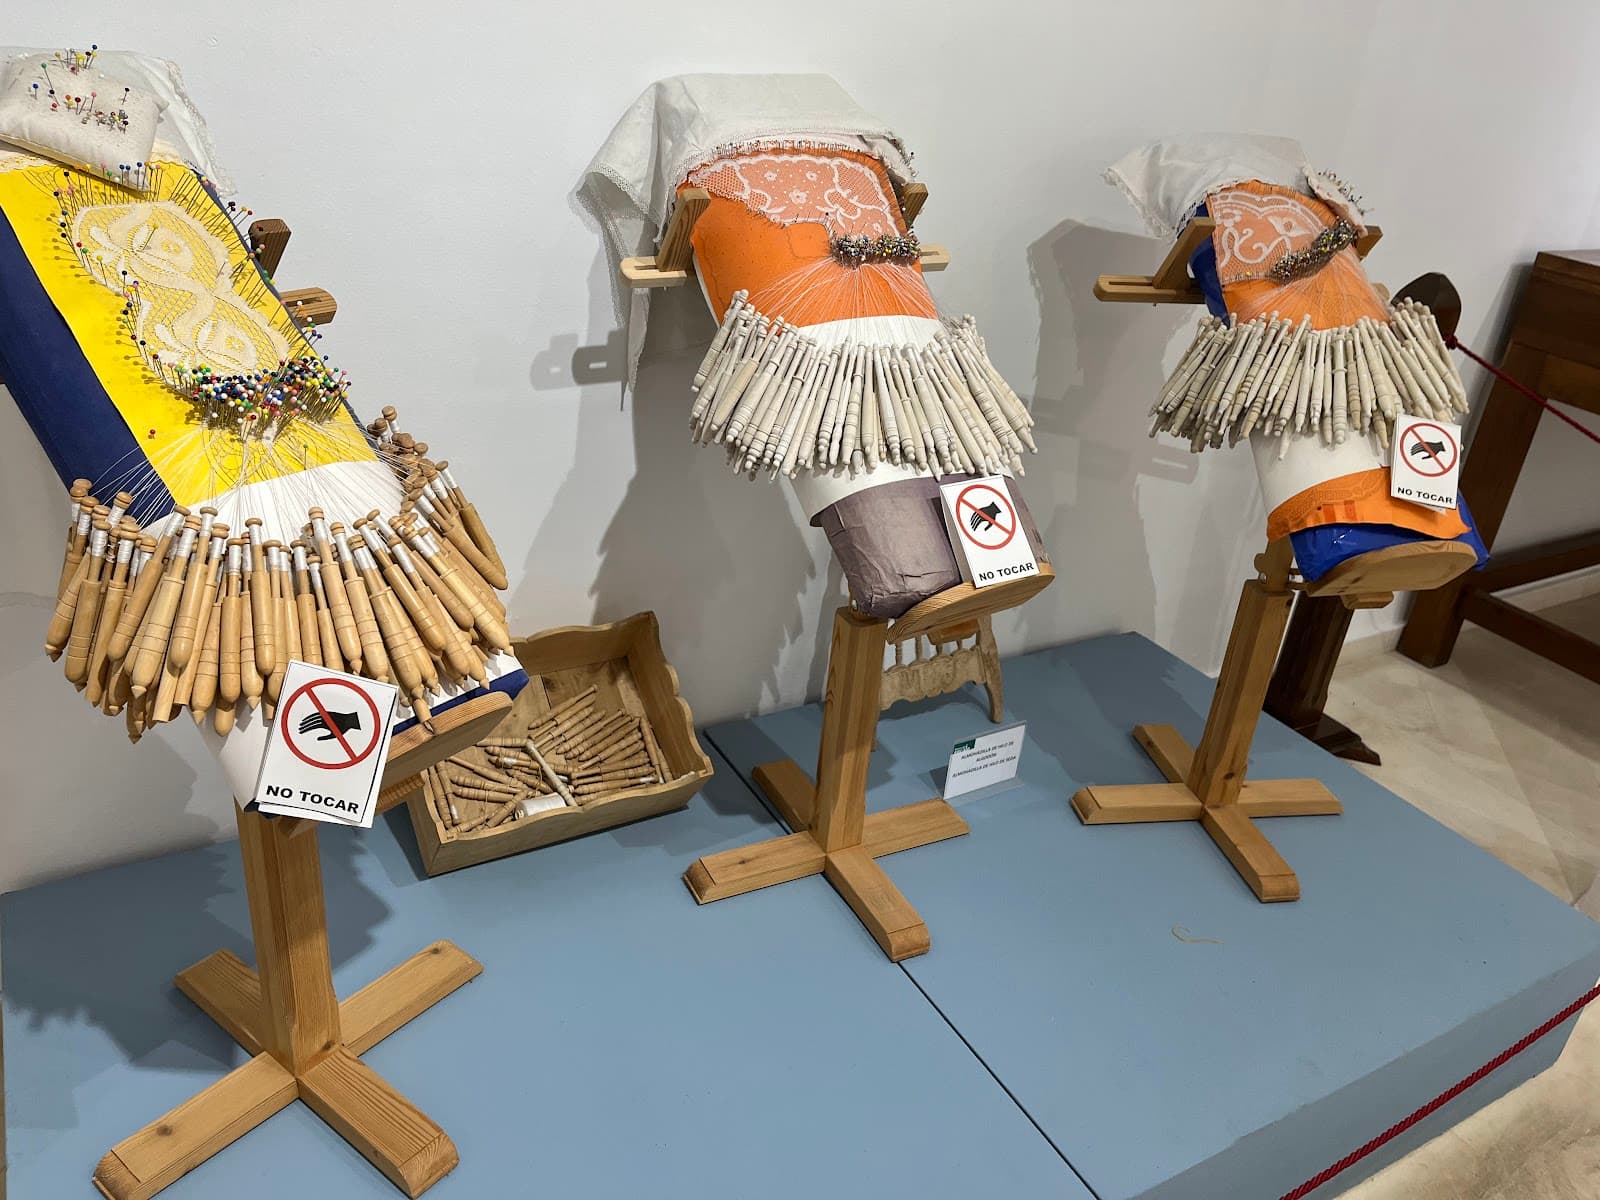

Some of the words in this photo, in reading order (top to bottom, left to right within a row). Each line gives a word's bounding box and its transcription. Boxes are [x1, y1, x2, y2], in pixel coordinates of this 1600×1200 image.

[1397, 487, 1413, 496] NO
[1416, 490, 1453, 504] TOCAR
[978, 571, 995, 581] NO
[997, 562, 1034, 577] TOCAR
[961, 748, 990, 759] ALMOHADILLA
[952, 766, 982, 777] ALMOHADILLA
[266, 785, 293, 799] NO
[299, 790, 359, 814] TOCAR
